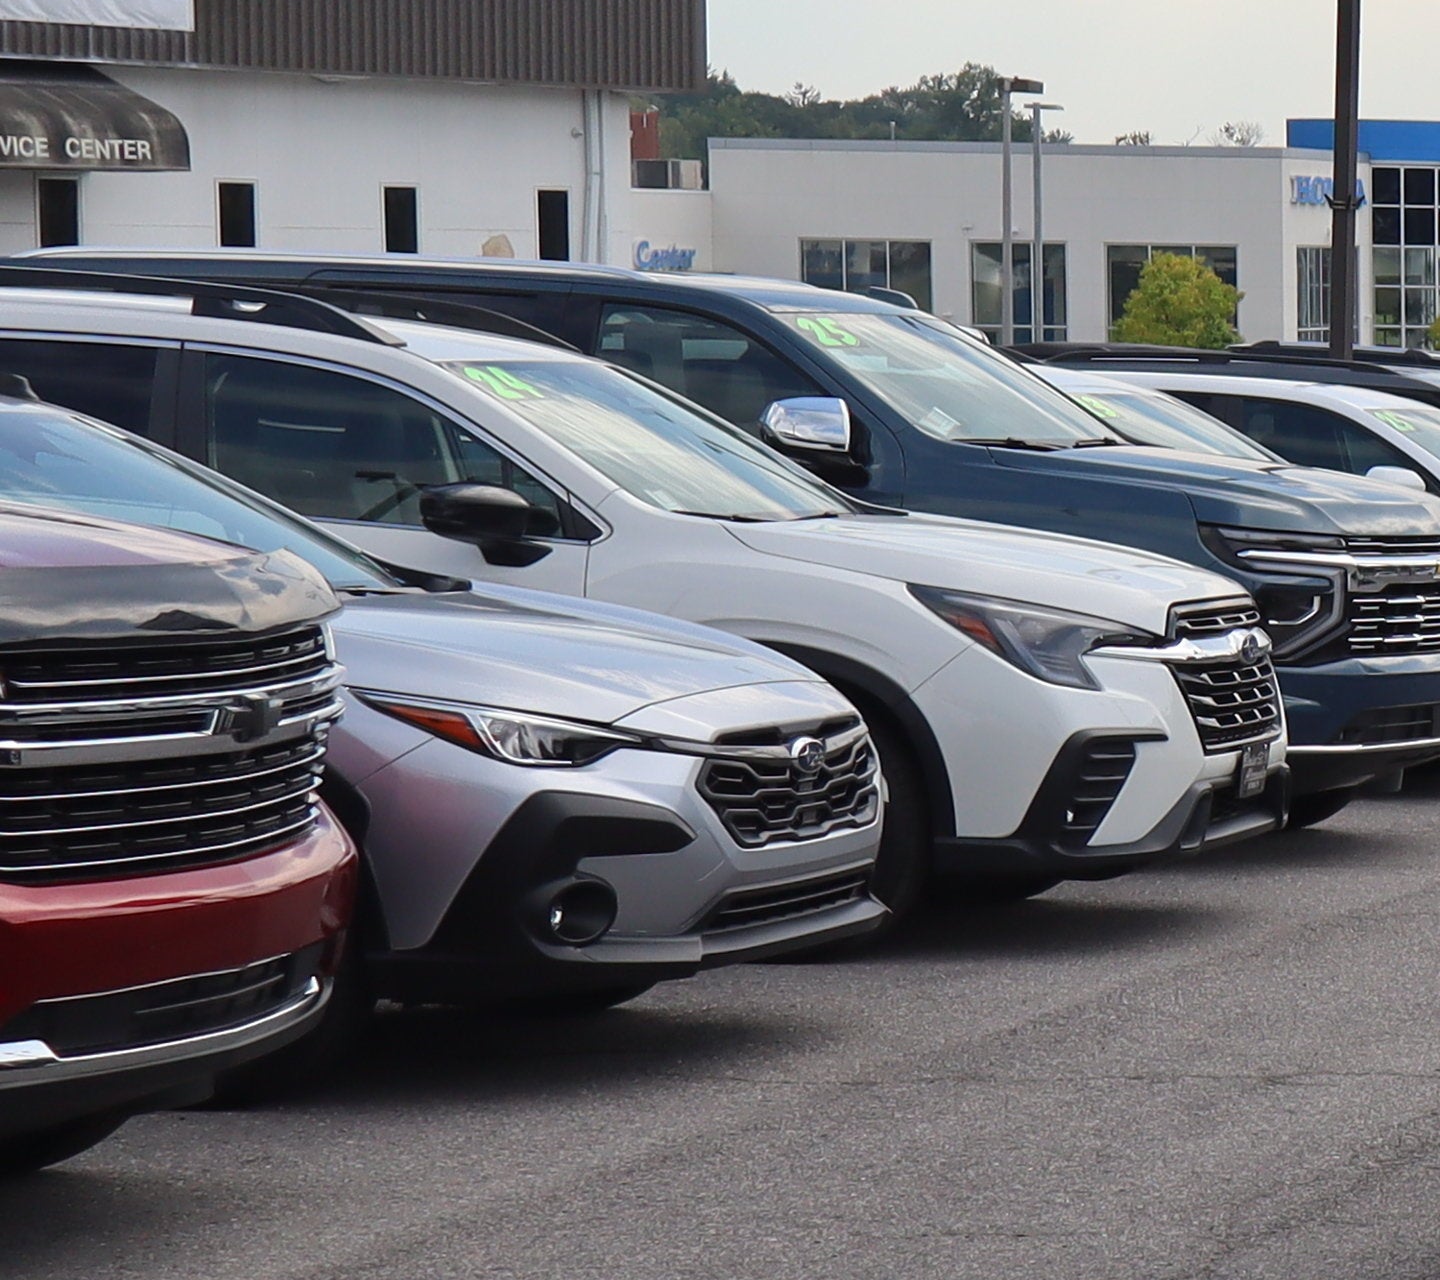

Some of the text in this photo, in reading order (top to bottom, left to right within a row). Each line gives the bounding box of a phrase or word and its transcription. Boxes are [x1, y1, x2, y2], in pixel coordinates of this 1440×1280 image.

[65, 138, 152, 160] CENTER
[1290, 175, 1367, 205] HONA
[796, 317, 861, 347] 25
[463, 365, 546, 400] 24
